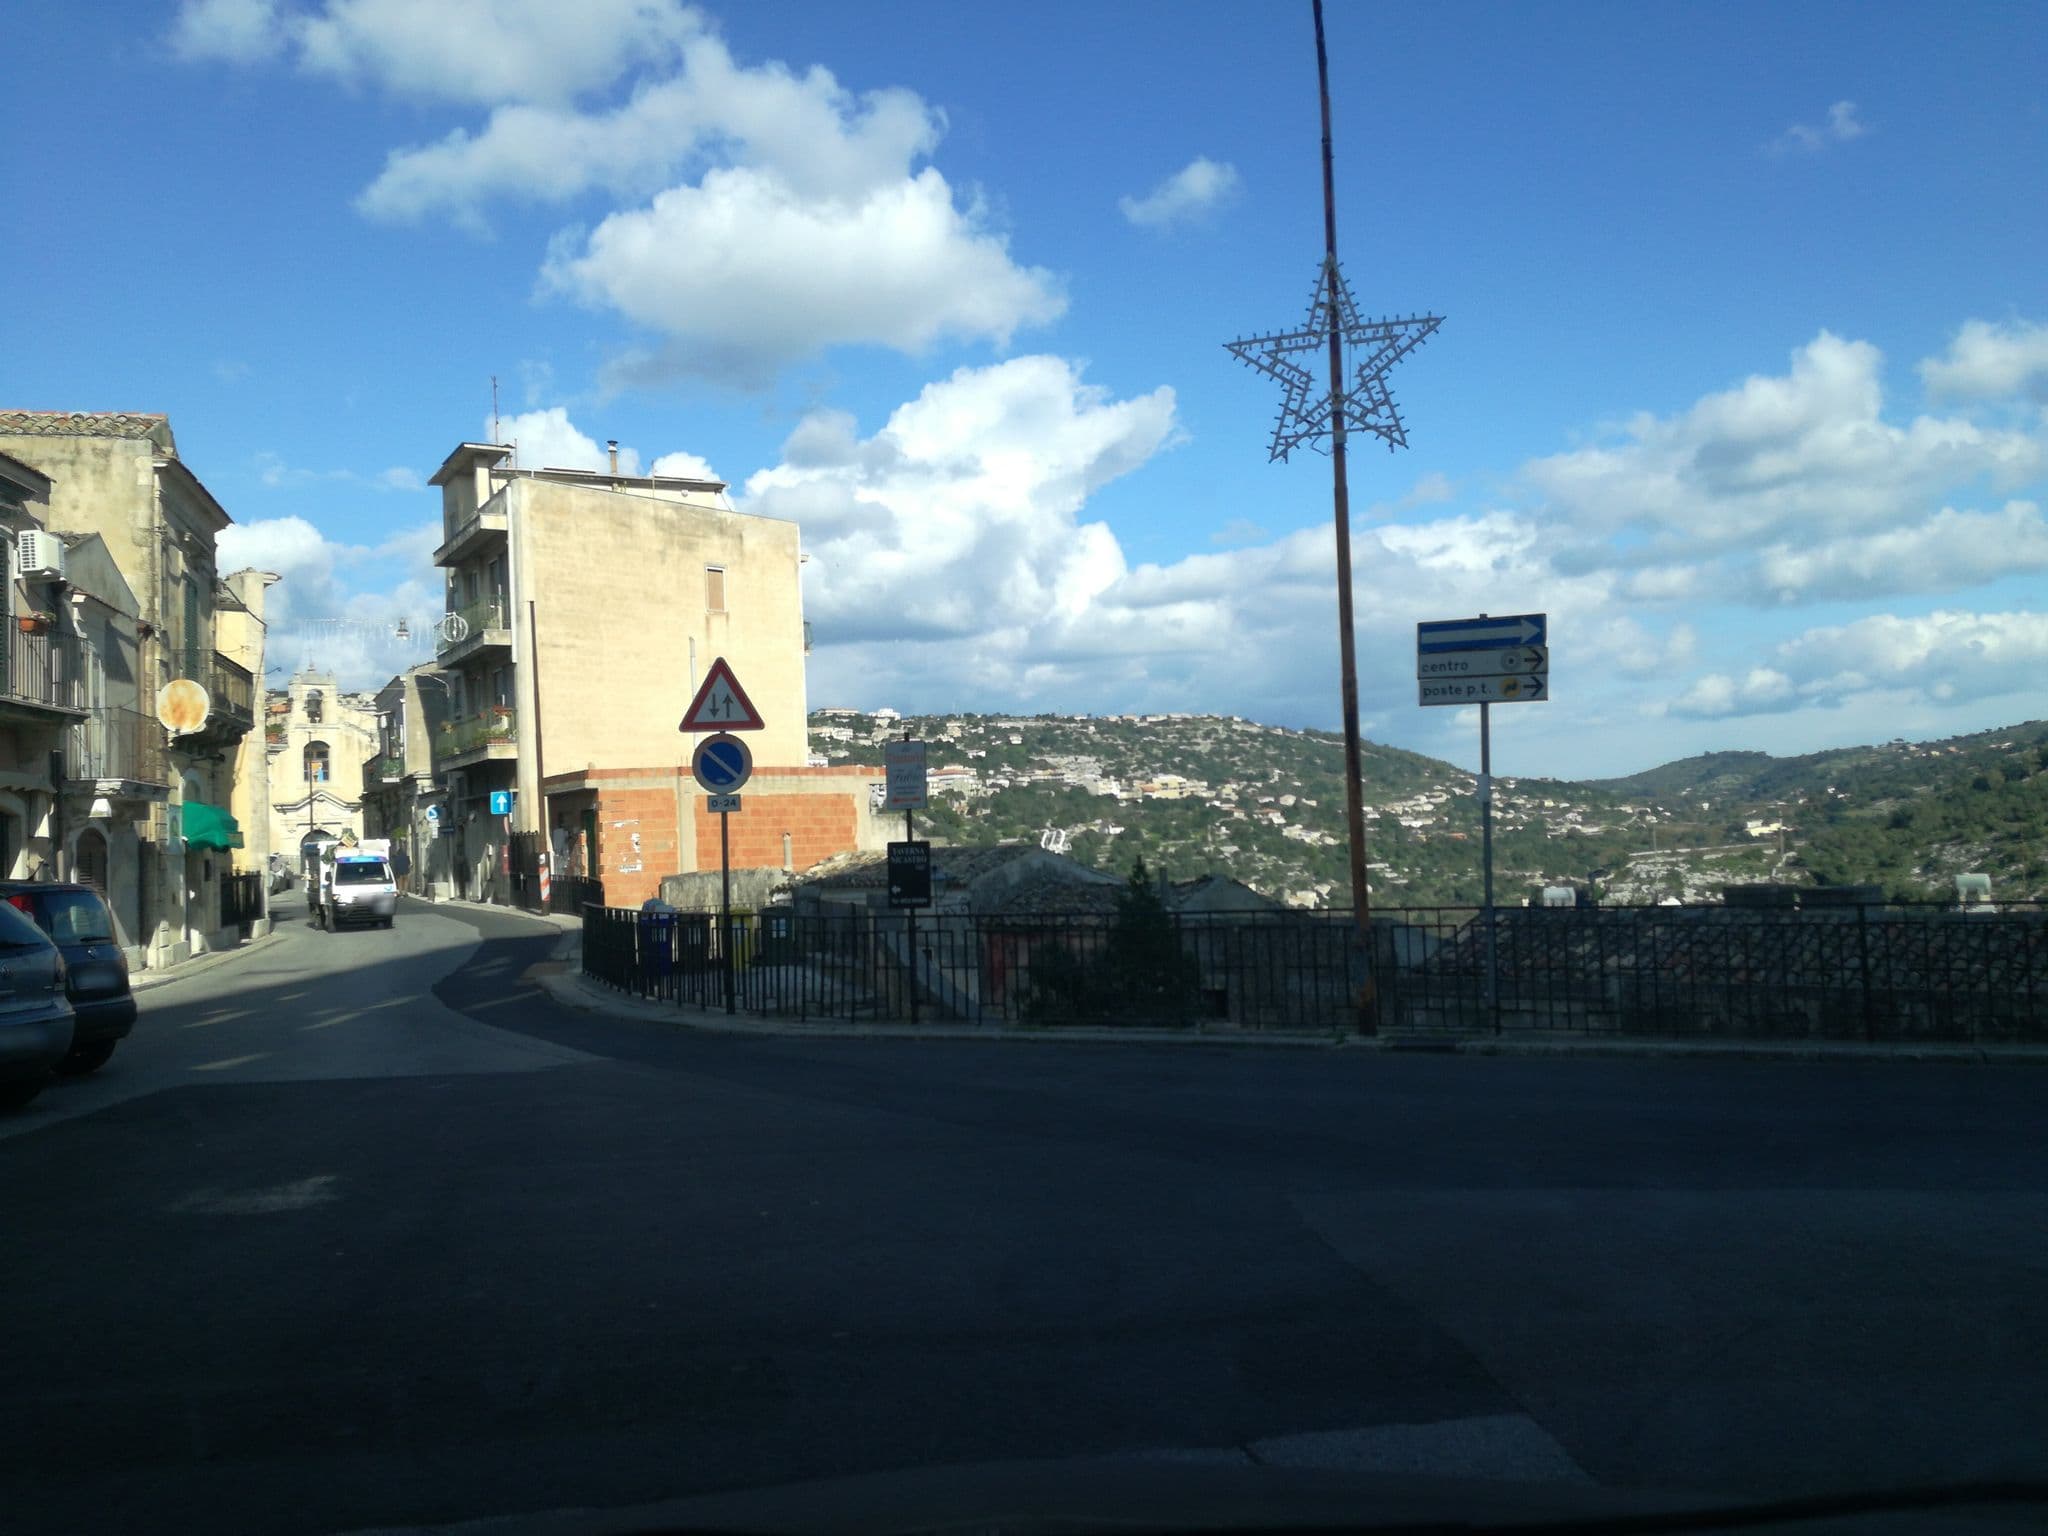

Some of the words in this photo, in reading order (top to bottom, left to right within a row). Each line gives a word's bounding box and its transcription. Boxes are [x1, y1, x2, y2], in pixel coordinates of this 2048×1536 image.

[1422, 661, 1469, 673] centro
[1423, 684, 1463, 698] poste
[891, 847, 927, 856] TAVERNA
